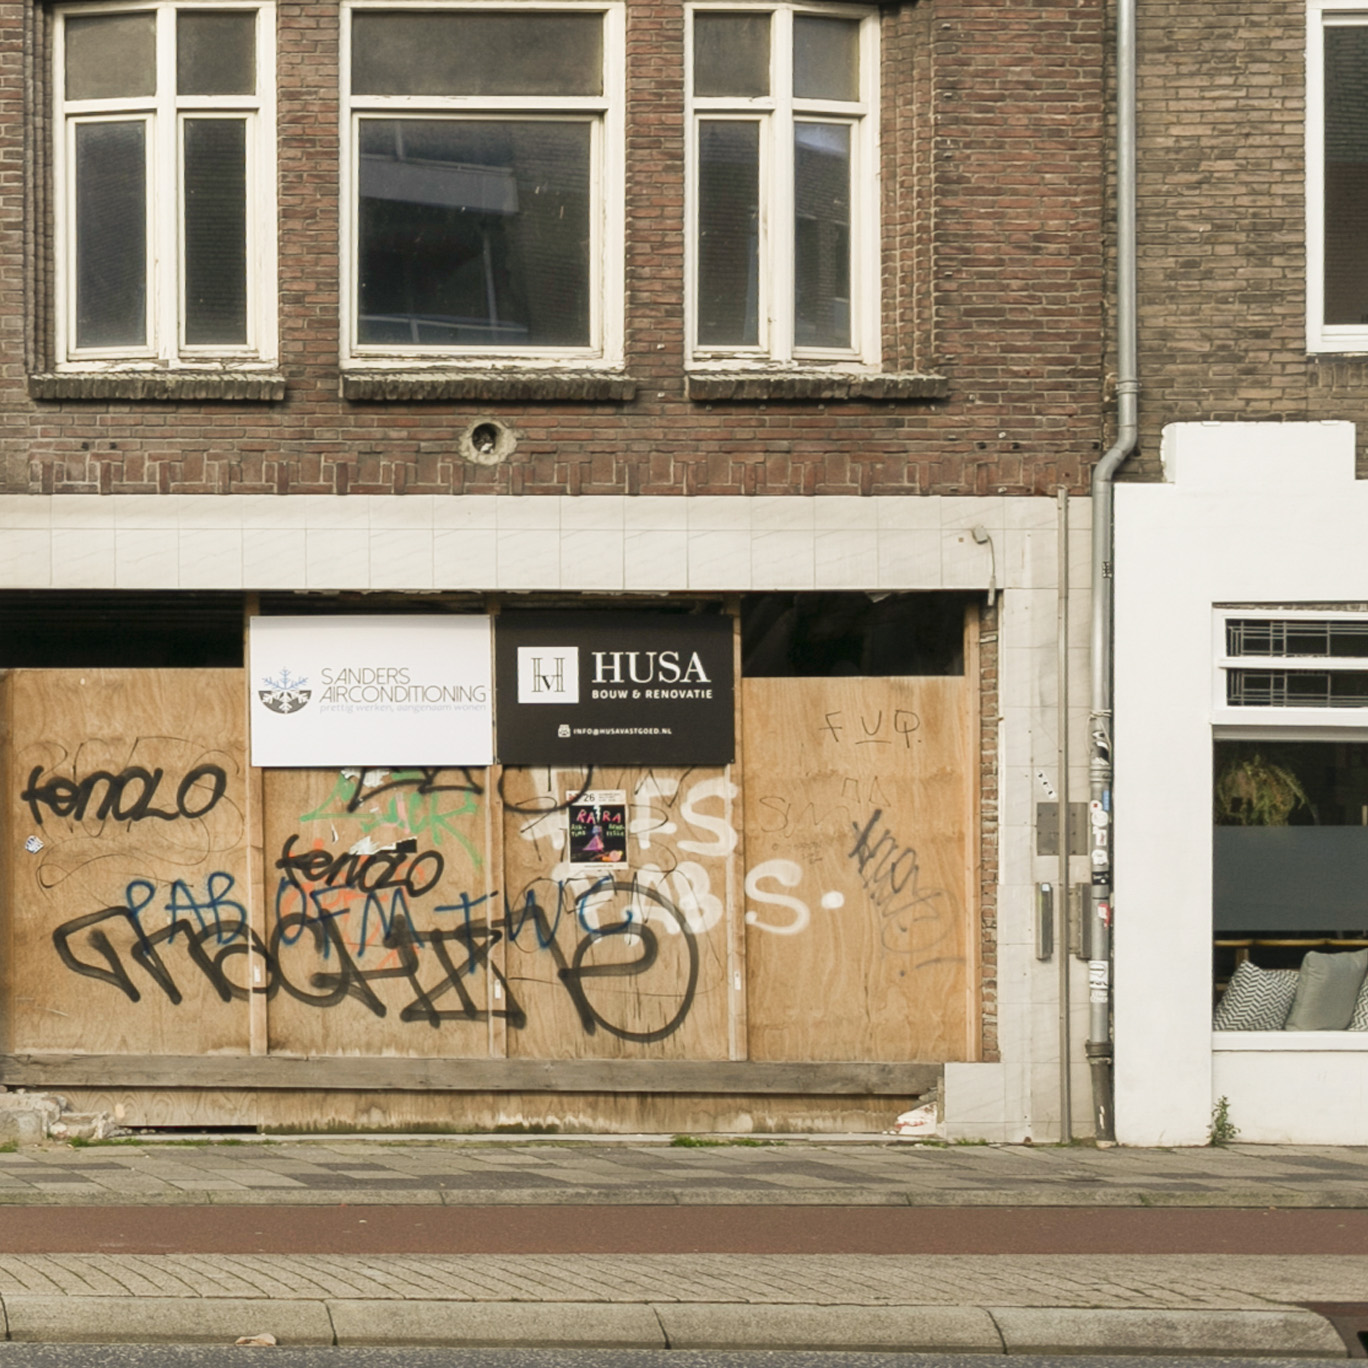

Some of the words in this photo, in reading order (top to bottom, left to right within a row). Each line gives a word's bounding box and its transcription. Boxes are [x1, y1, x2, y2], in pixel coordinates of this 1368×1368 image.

[320, 667, 411, 685] SANDERS
[591, 651, 711, 683] HUSA
[319, 685, 486, 703] AIRCONDITIONING
[592, 689, 628, 699] BOUW
[632, 689, 641, 699] &
[645, 689, 713, 699] RENOVATIE
[320, 703, 353, 714] prettig
